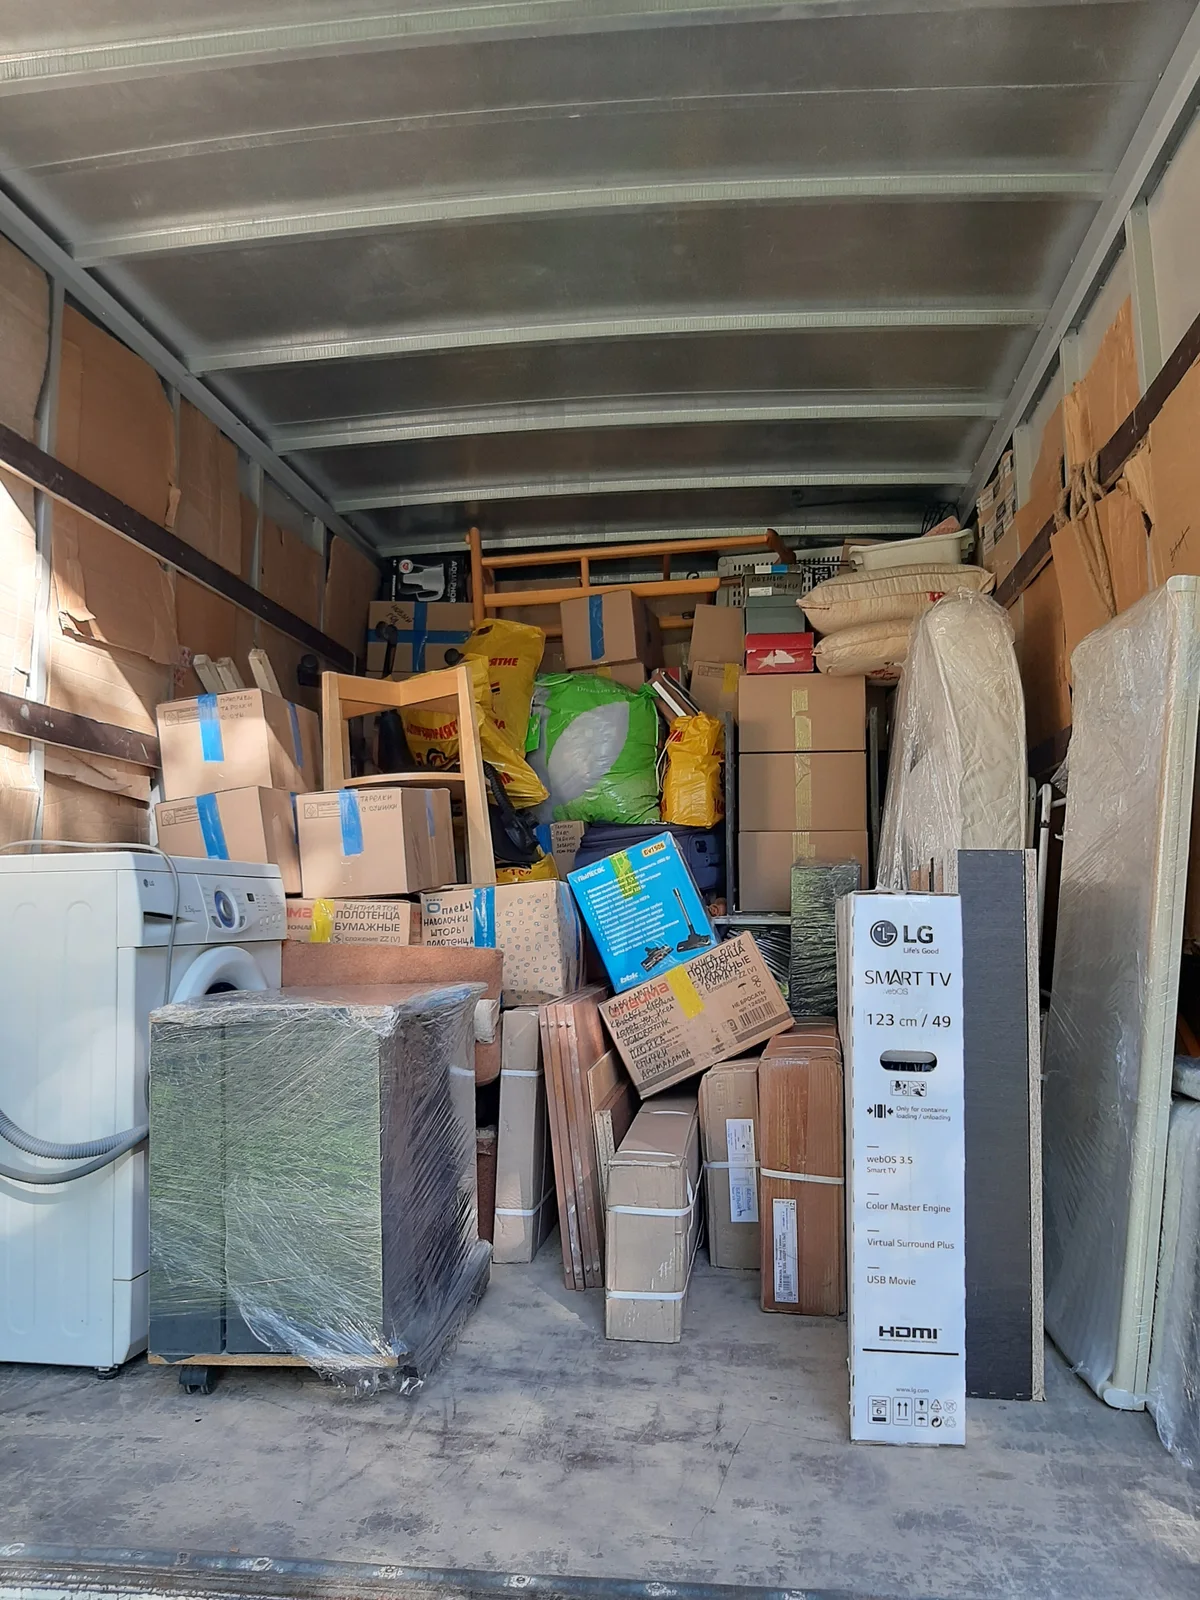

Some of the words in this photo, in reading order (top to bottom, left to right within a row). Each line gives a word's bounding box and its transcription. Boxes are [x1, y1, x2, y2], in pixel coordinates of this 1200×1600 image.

[336, 910, 400, 921] ПОЛОТЕНЦА
[424, 915, 468, 926] НАВОЛОЧКИ
[334, 923, 400, 932] БУМАЖНЫЕ
[431, 927, 464, 937] ШТОРЫ
[904, 925, 934, 944] LG
[619, 971, 639, 984] bbk
[864, 969, 923, 985] SMART
[927, 972, 952, 987] TV
[867, 1014, 894, 1026] 123
[899, 1017, 917, 1027] cm
[922, 1014, 928, 1028] /
[932, 1015, 951, 1028] 49
[867, 1156, 897, 1164] webOS
[899, 1156, 913, 1164] 3.5
[866, 1202, 888, 1210] Color
[891, 1203, 920, 1212] Master
[923, 1204, 951, 1214] Engine
[868, 1238, 895, 1247] Virtual
[897, 1240, 934, 1248] Surround
[937, 1241, 954, 1249] Plus
[867, 1276, 886, 1284] USB
[889, 1276, 916, 1285] Movie
[879, 1326, 938, 1339] HDMI
